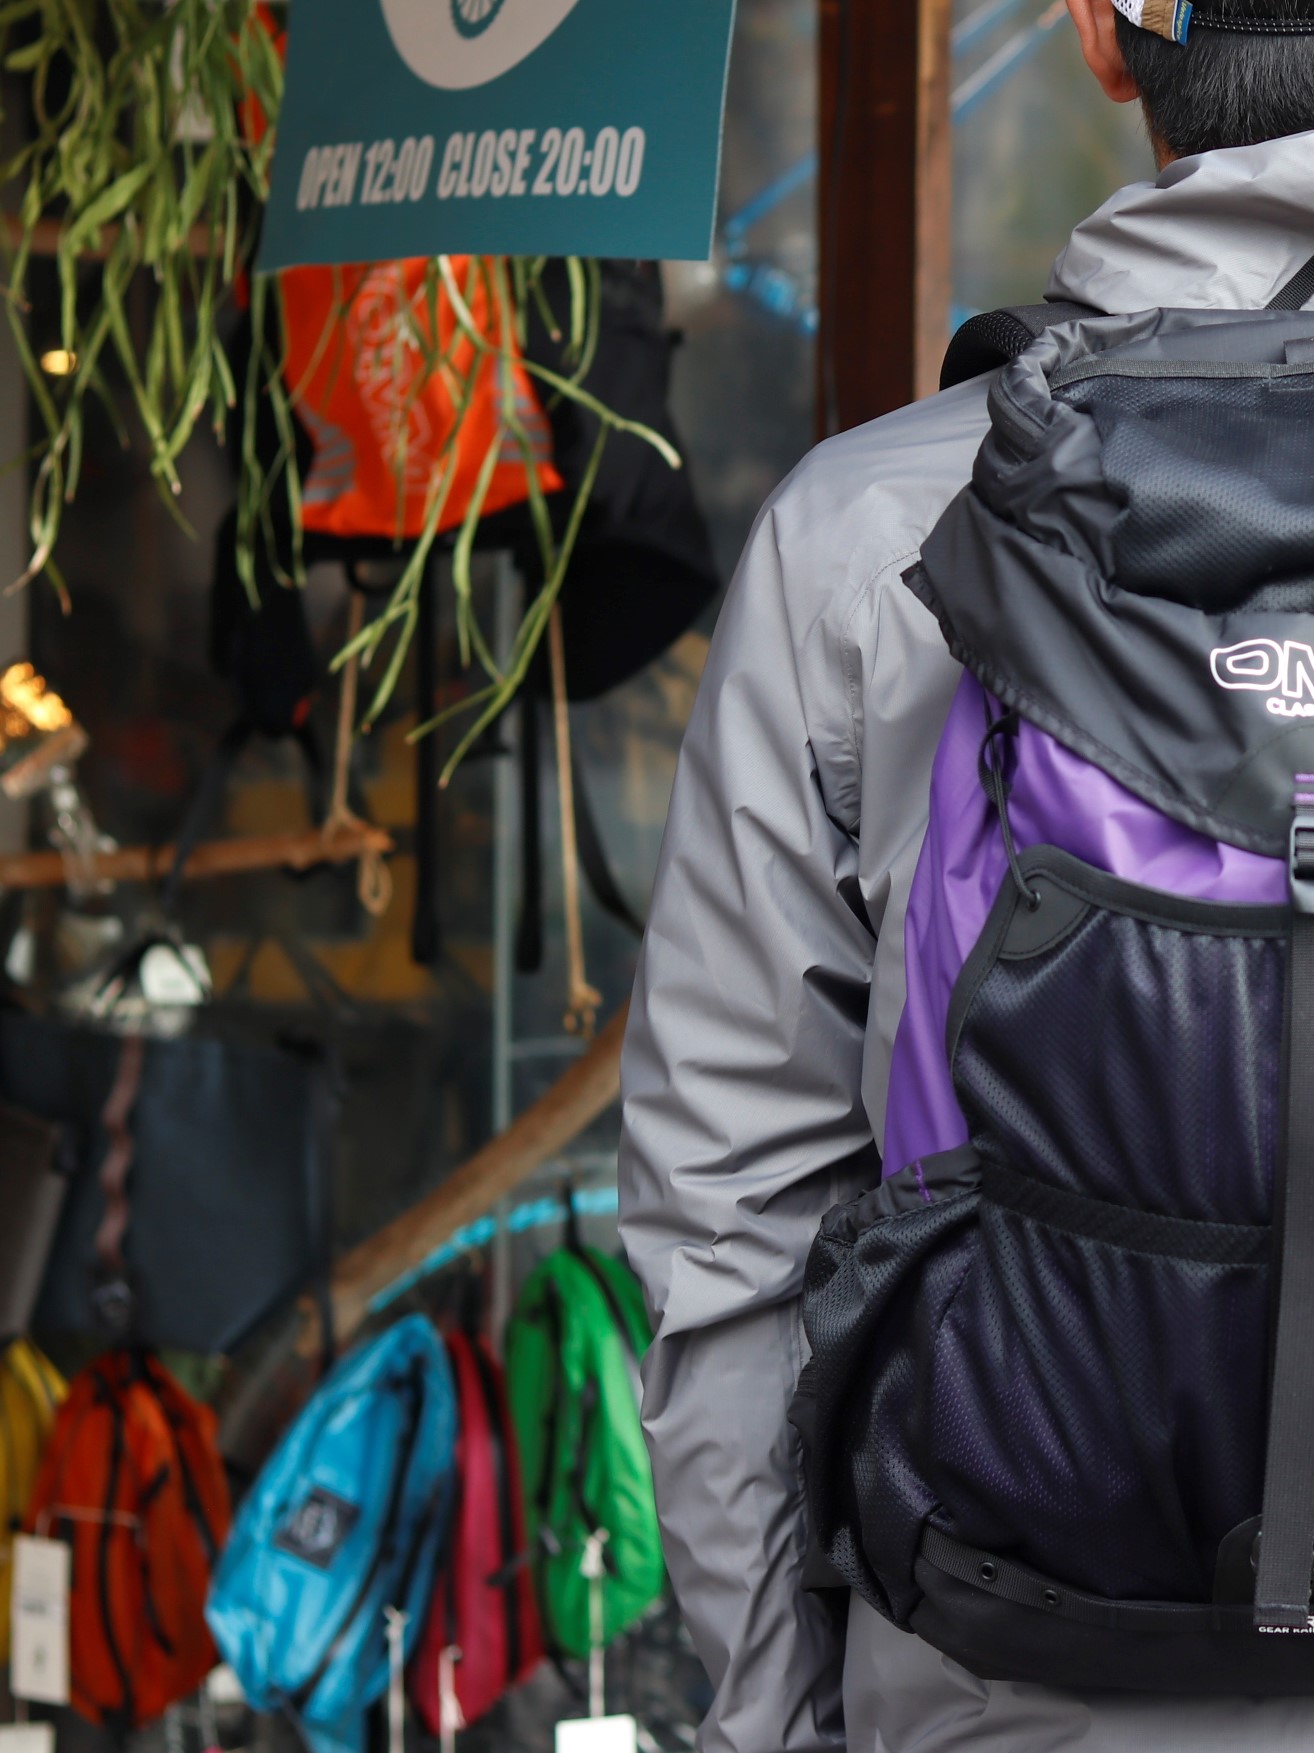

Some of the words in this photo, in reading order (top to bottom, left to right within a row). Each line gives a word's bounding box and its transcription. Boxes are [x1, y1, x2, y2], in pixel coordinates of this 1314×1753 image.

[297, 142, 362, 210] OPEN
[361, 136, 434, 204] 12:00
[437, 129, 536, 199] CLOSE
[531, 126, 646, 197] 20:00
